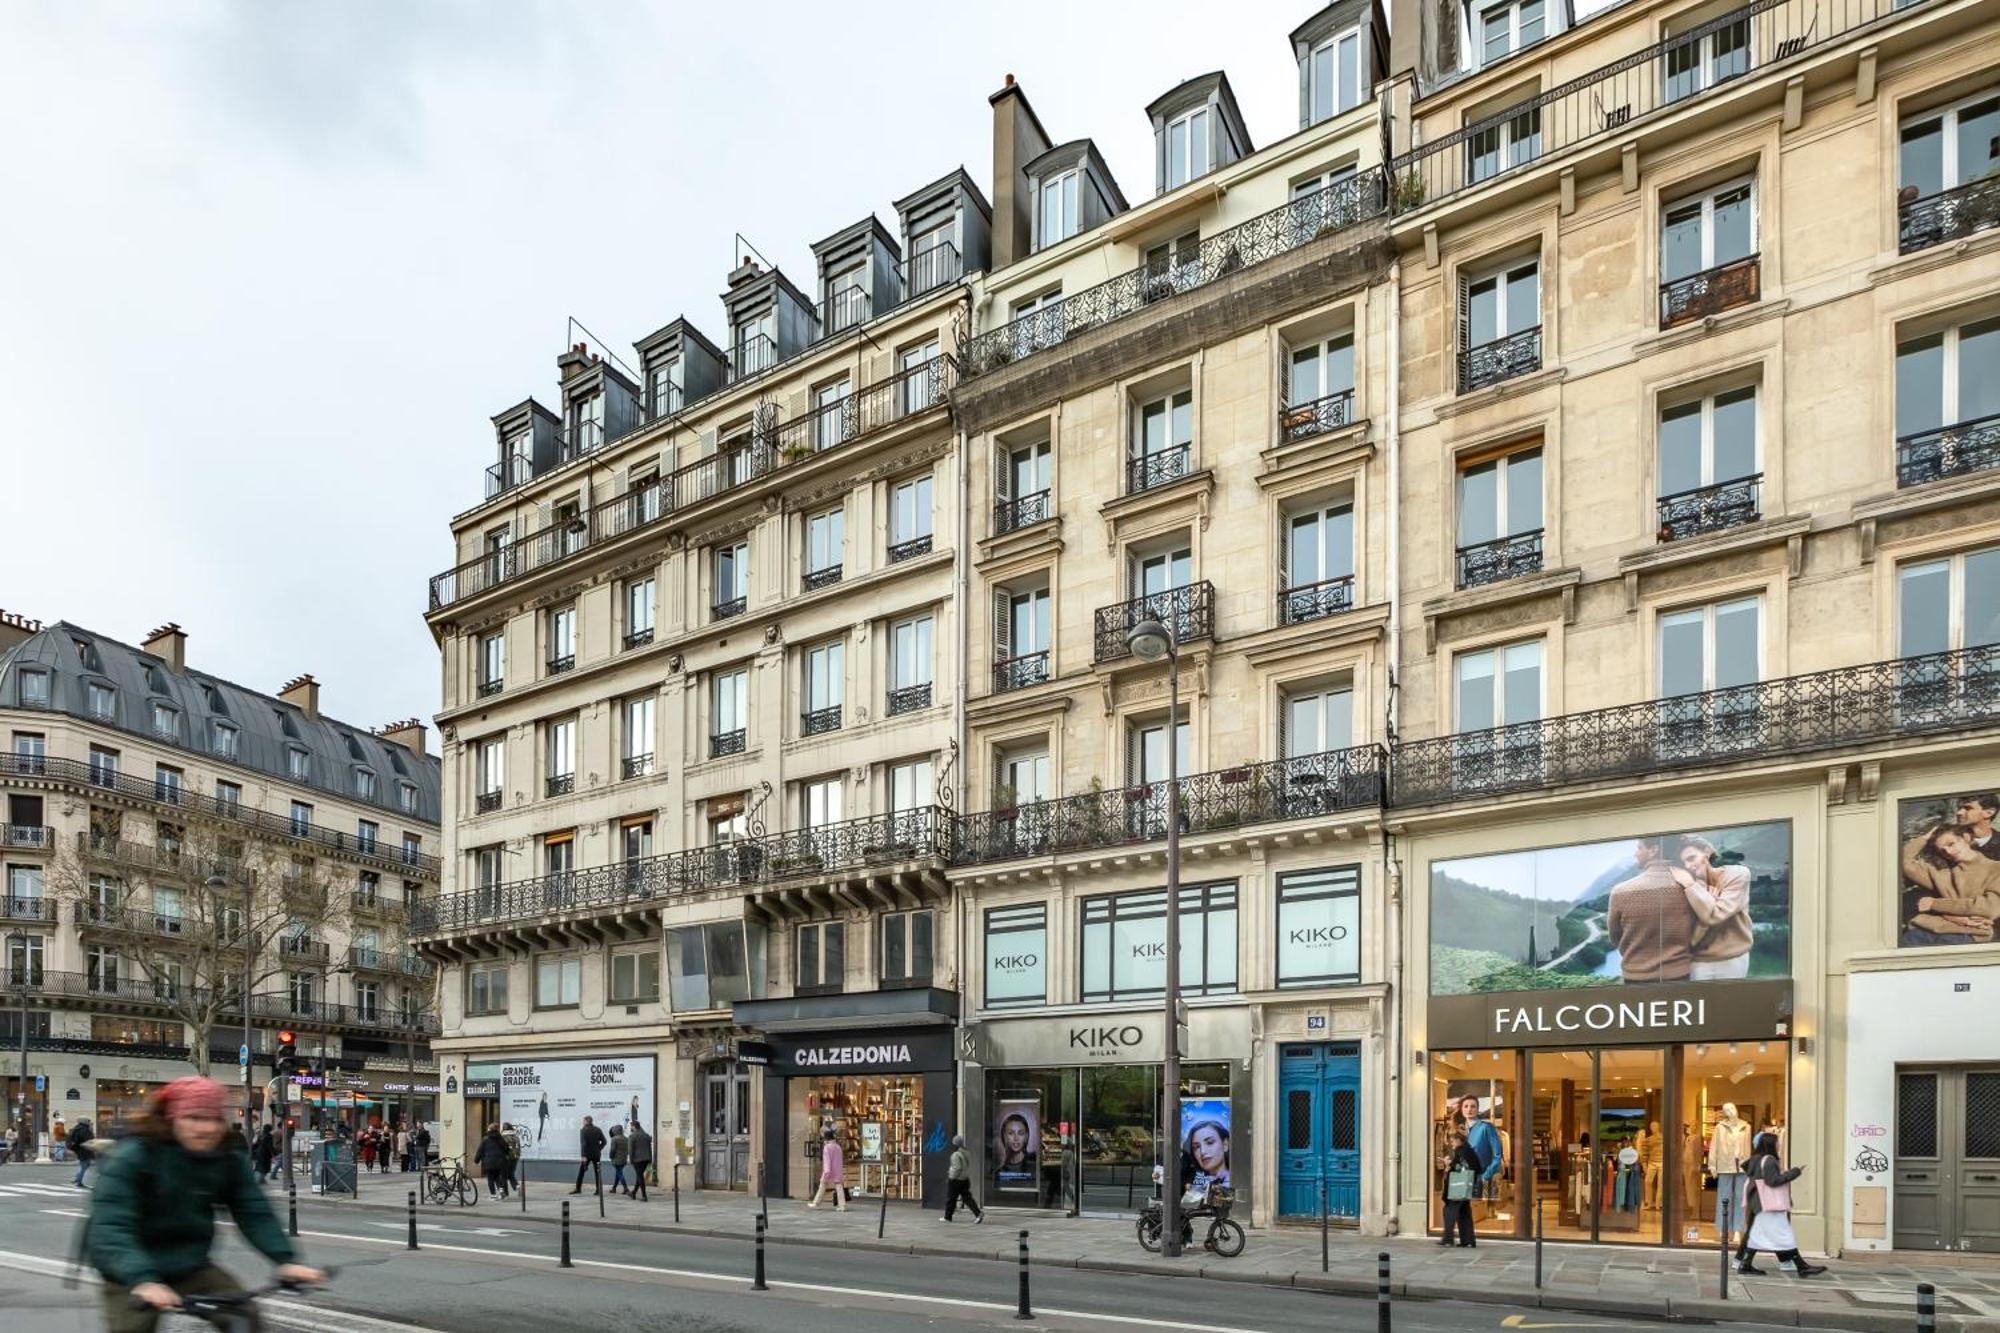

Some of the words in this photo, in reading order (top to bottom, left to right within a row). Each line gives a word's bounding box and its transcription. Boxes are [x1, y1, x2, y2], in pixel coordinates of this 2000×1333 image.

[1290, 926, 1347, 944] KIKO
[1132, 943, 1181, 958] KIK
[995, 954, 1037, 969] KIKO
[1310, 1017, 1323, 1027] 94
[1496, 1000, 1704, 1033] FALCONERI
[1070, 1026, 1143, 1048] KIKO
[795, 1045, 912, 1066] CALZEDONIA
[503, 1066, 534, 1077] GRANDE
[590, 1063, 625, 1074] COMING
[503, 1075, 541, 1086] BRADERIE
[590, 1073, 622, 1085] SOON...
[467, 1082, 496, 1095] minelli
